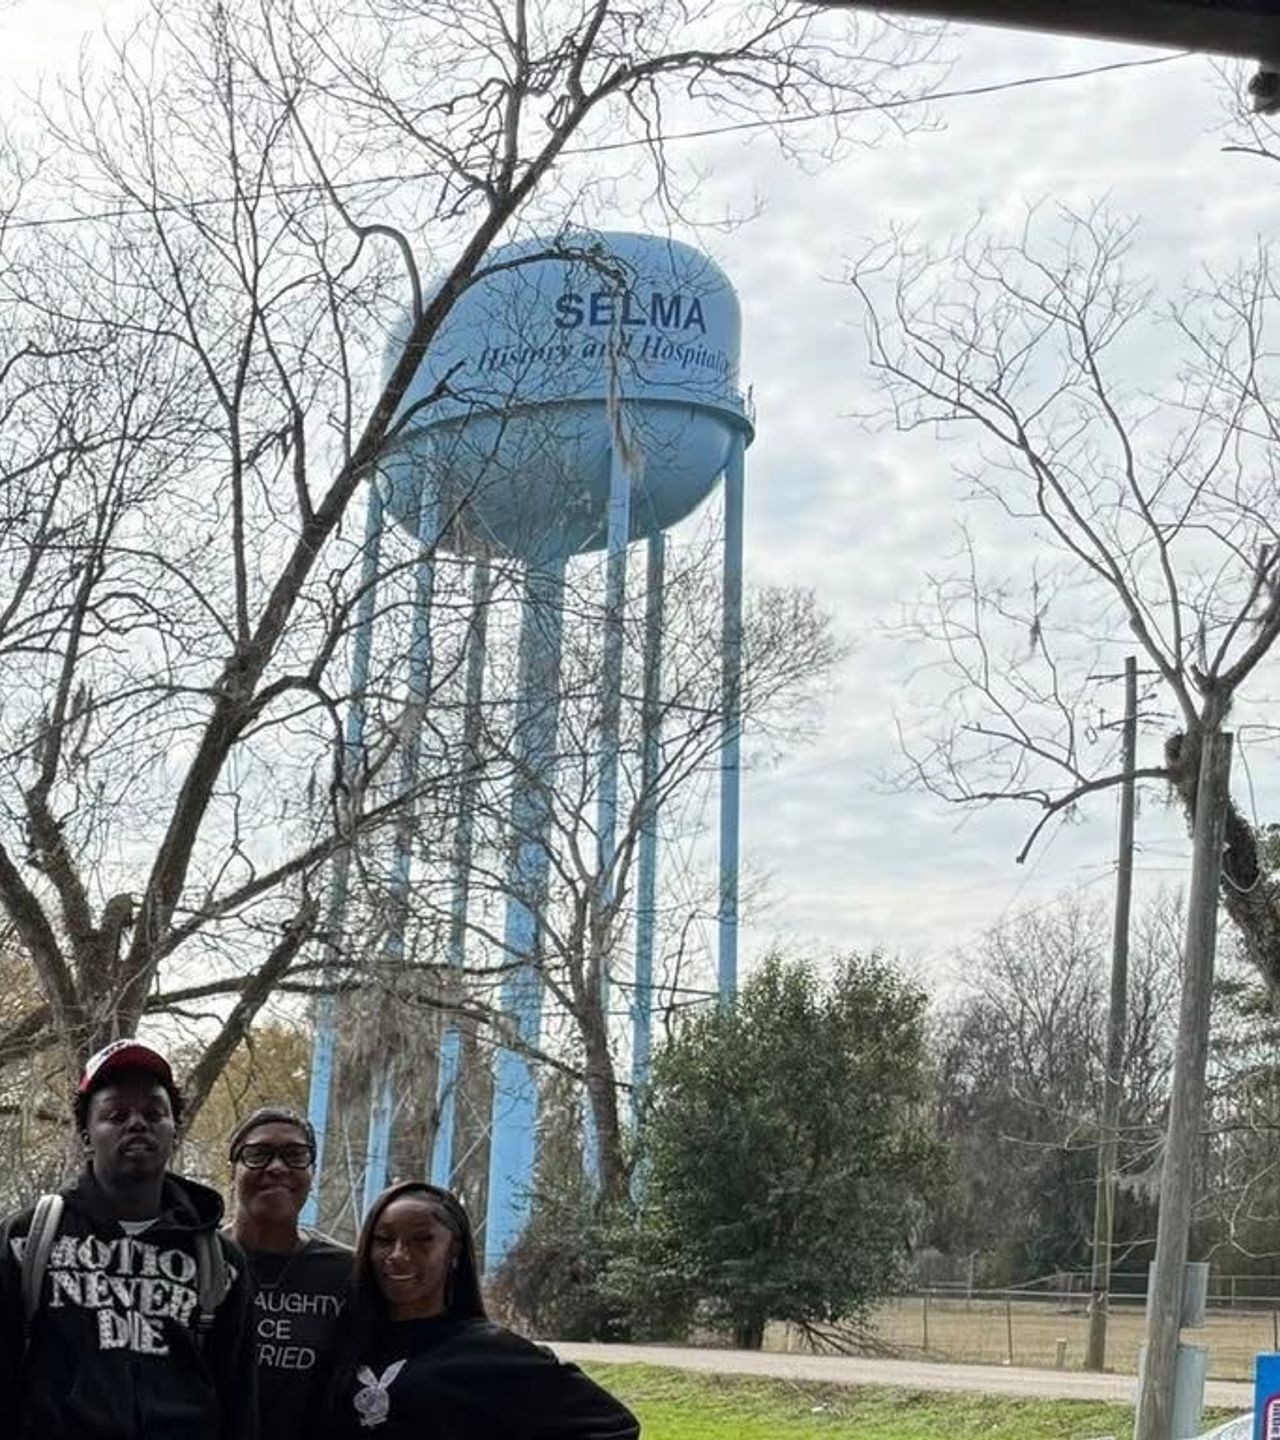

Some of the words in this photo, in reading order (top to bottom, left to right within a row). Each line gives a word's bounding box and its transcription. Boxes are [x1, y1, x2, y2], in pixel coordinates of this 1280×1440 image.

[554, 292, 707, 334] SELMA
[47, 1269, 200, 1327] NEVER
[96, 1307, 171, 1356] DIE
[256, 1343, 317, 1370] RIED
